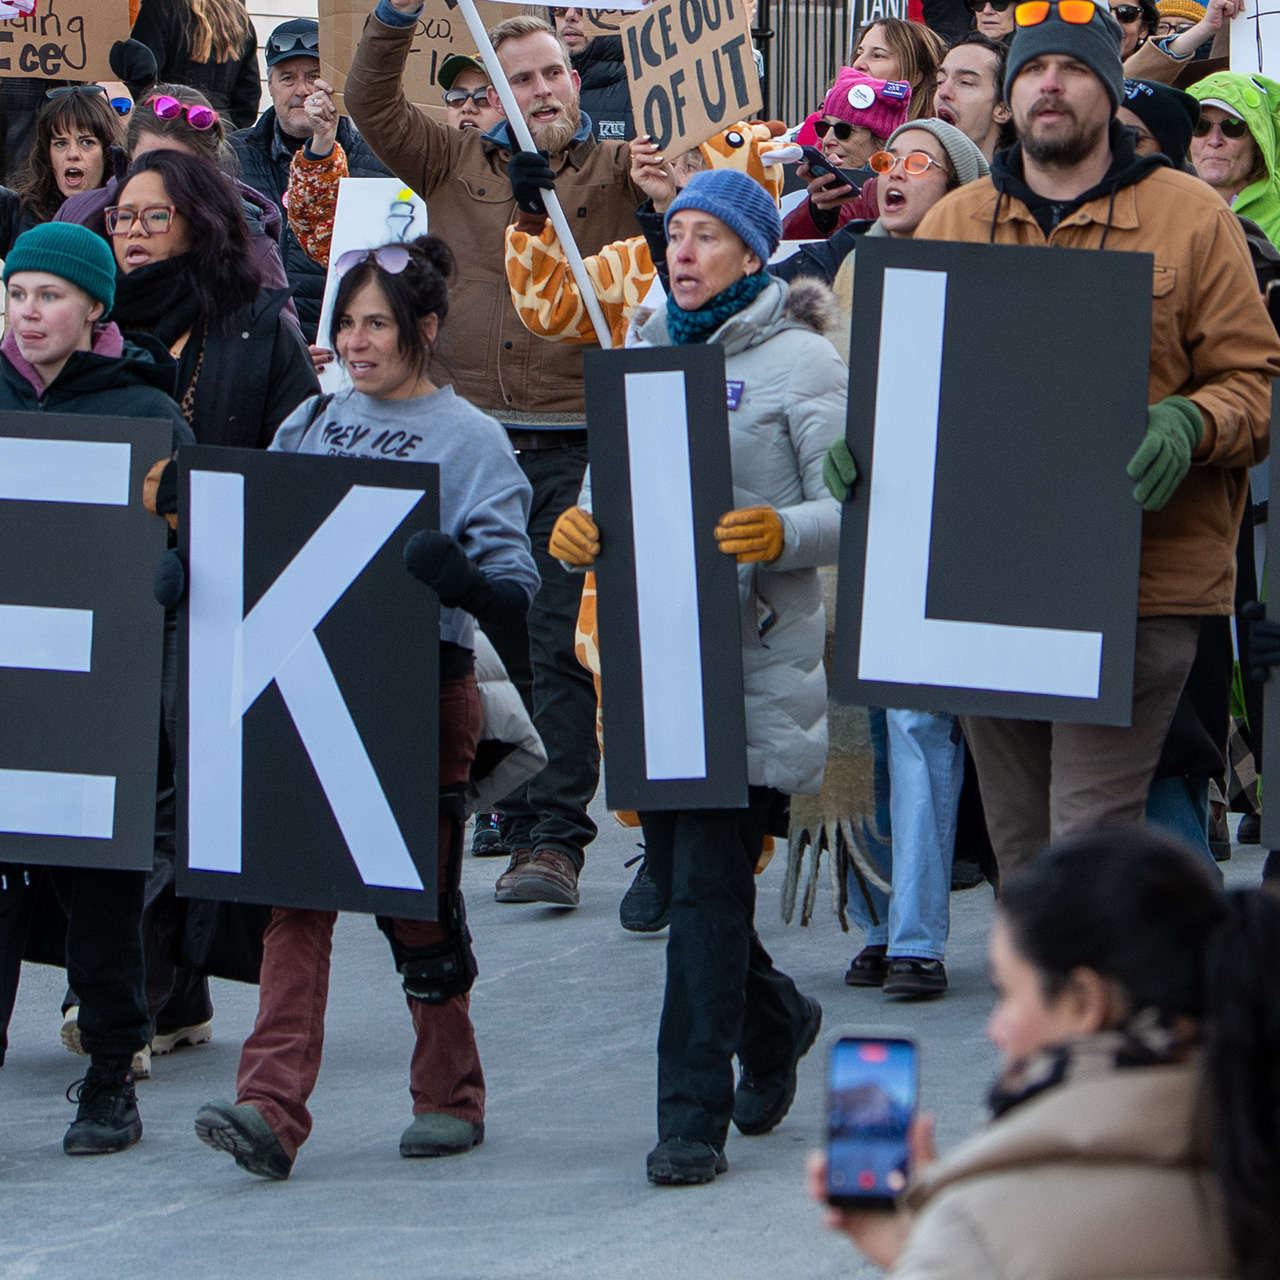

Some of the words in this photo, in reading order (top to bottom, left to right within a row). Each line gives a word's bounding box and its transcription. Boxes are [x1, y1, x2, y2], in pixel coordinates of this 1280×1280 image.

[626, 3, 678, 81] ICE
[644, 67, 689, 152] OF
[698, 33, 749, 123] UT
[321, 422, 370, 450] HEY
[371, 429, 423, 457] ICE
